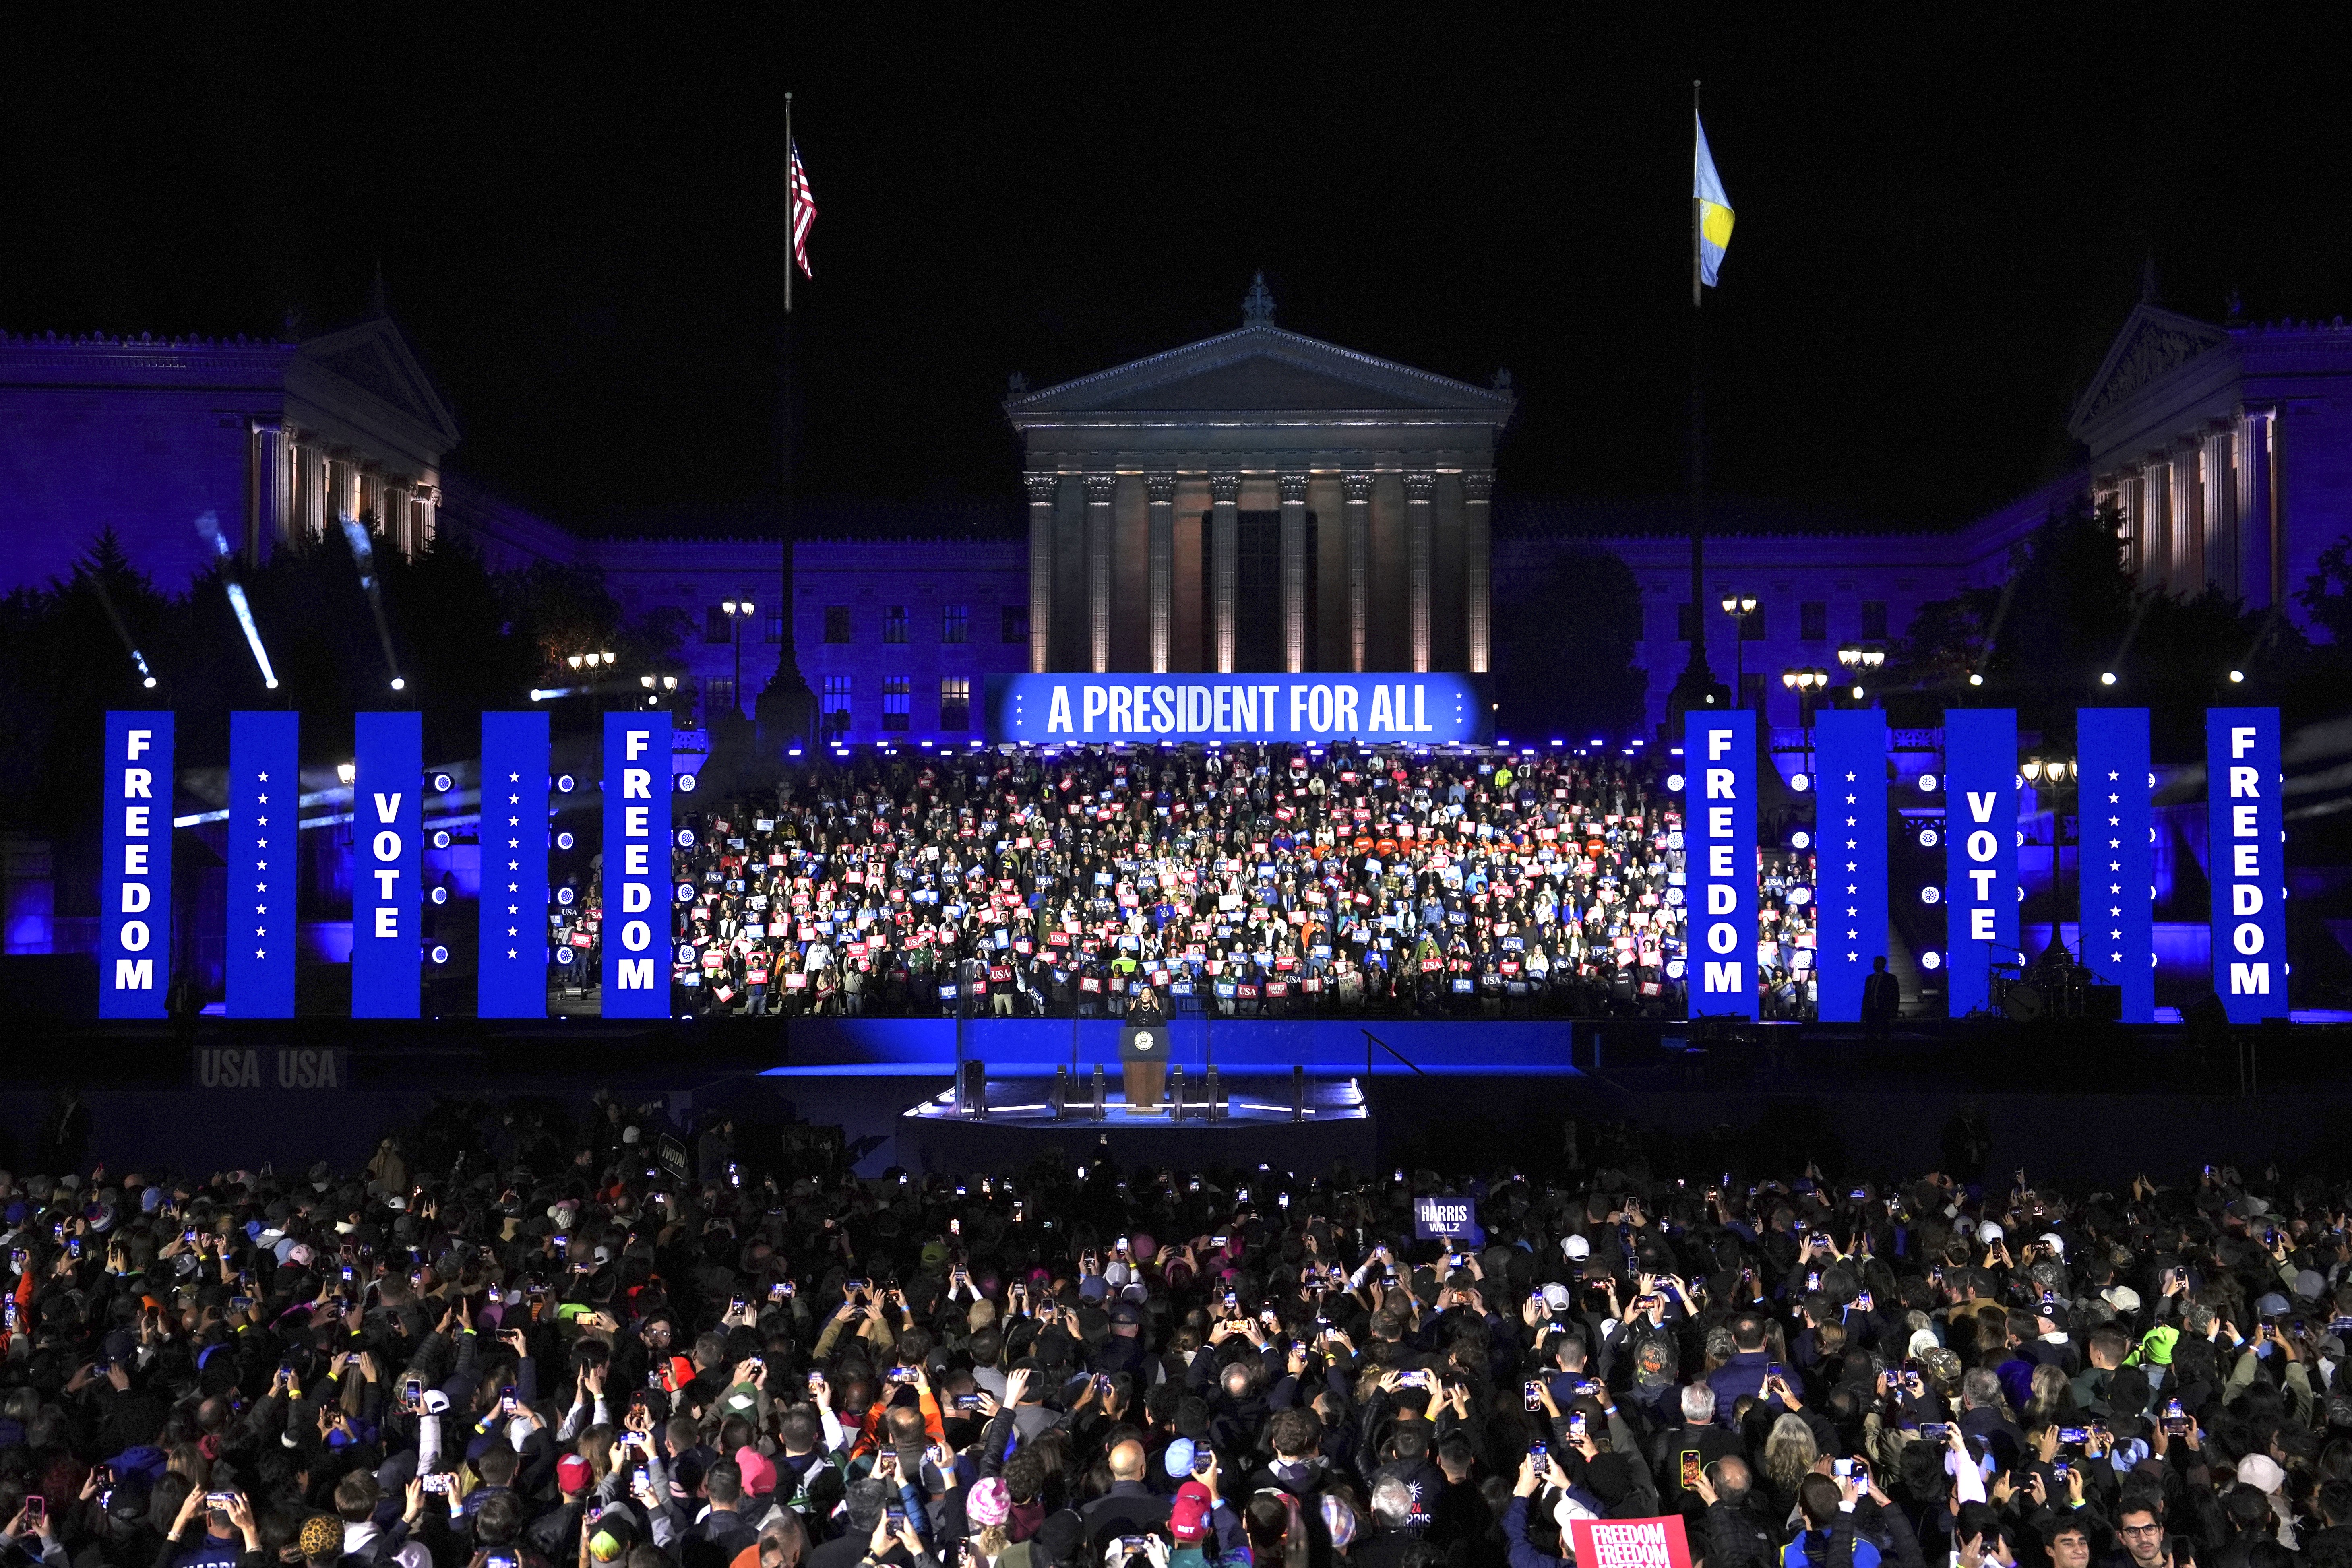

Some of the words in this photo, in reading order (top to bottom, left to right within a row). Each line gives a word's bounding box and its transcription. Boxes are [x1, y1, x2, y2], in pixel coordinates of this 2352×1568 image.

[1047, 686, 1073, 733] A
[1083, 686, 1279, 733] PRESIDENT
[1291, 685, 1358, 732] FOR
[1368, 685, 1432, 732] ALL
[116, 730, 152, 989] FREEDOM
[618, 731, 654, 989] FREEDOM
[1705, 730, 1741, 992] FREEDOM
[2230, 727, 2269, 994] FREEDOM
[373, 793, 401, 937] VOTE
[1283, 865, 1297, 874] USA
[1967, 792, 1997, 939] VOTE
[897, 870, 913, 880] USA
[943, 875, 959, 883] USA
[991, 896, 1006, 905] USA
[1255, 910, 1270, 918] USA
[1449, 913, 1465, 923] USA
[1354, 932, 1370, 940] USA
[1611, 928, 1620, 936] US
[1780, 933, 1790, 941] US
[1051, 934, 1068, 943] USA
[978, 940, 994, 948] USA
[1505, 940, 1523, 950] USA
[1423, 961, 1441, 970] USA
[991, 970, 1010, 979] USA
[1286, 975, 1301, 983] USA
[1483, 977, 1501, 985] USA
[818, 987, 833, 997] HARRIS
[1030, 988, 1045, 1004] USA
[1239, 987, 1256, 996] USA
[201, 1049, 259, 1087] USA
[279, 1050, 337, 1088] USA
[1421, 1205, 1467, 1221] HARRIS
[1429, 1223, 1460, 1232] WALZ
[1412, 1502, 1422, 1514] 24
[1406, 1514, 1431, 1527] RRIS
[1591, 1523, 1666, 1545] FREEDOM
[1595, 1543, 1670, 1564] FREEDOM
